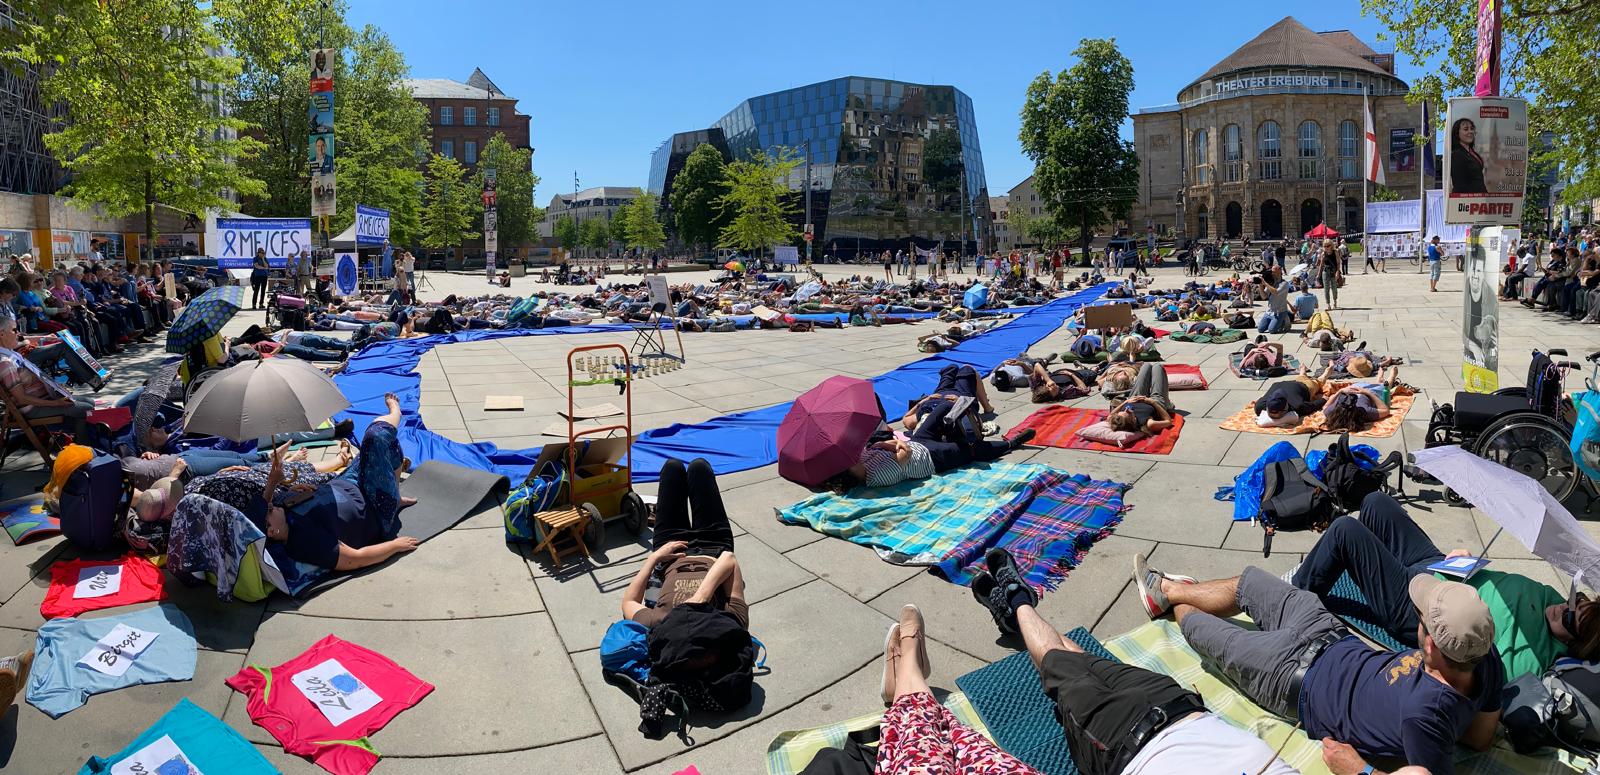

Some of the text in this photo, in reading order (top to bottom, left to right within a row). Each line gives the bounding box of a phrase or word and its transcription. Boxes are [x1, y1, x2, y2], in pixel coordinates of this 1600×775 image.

[1216, 75, 1329, 93] THEATER FREIBURG
[1458, 203, 1513, 215] Die PARTEI
[363, 215, 386, 237] ME/CFS
[240, 230, 300, 257] ME/CFS
[98, 631, 141, 667] Birgit
[306, 676, 352, 710] Leila
